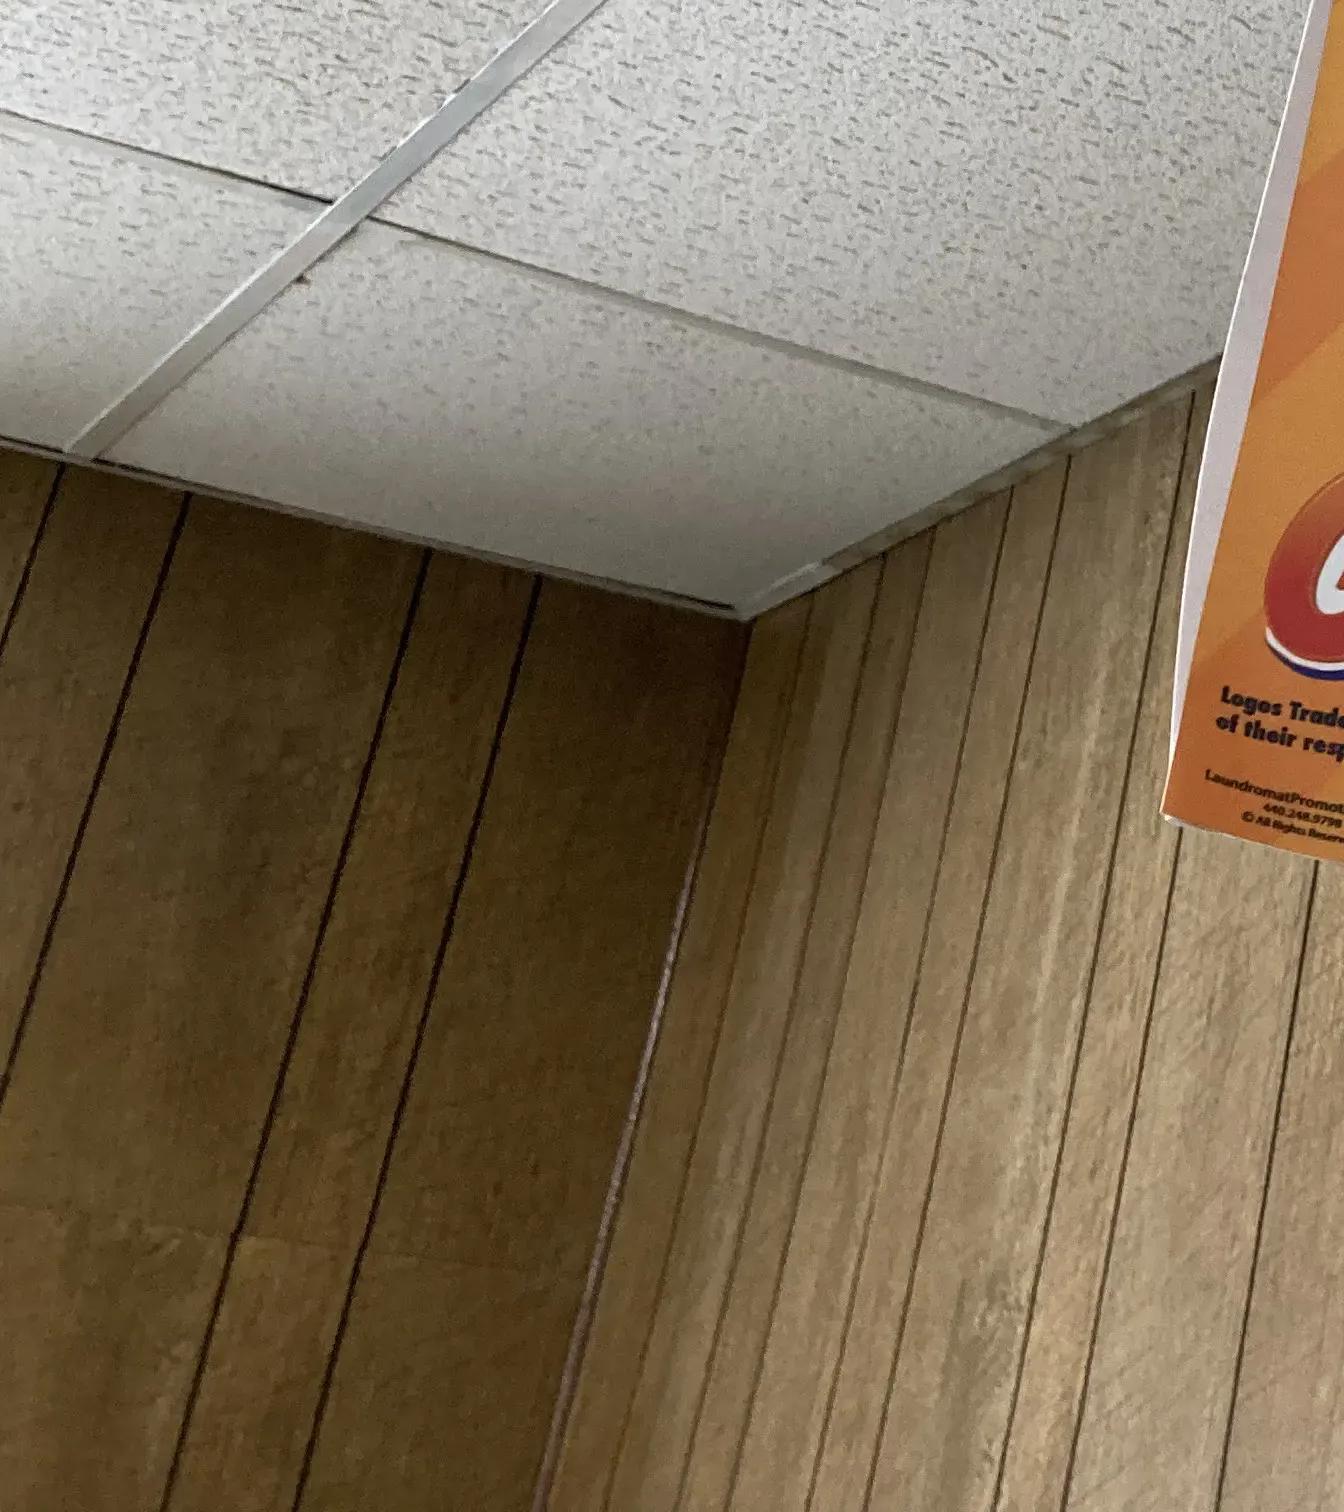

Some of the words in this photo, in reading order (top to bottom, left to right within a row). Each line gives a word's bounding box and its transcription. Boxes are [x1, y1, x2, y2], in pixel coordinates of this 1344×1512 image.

[1220, 685, 1283, 716] Logos
[1215, 714, 1239, 734] of
[1244, 720, 1298, 748] their
[1272, 819, 1306, 837] Rights
